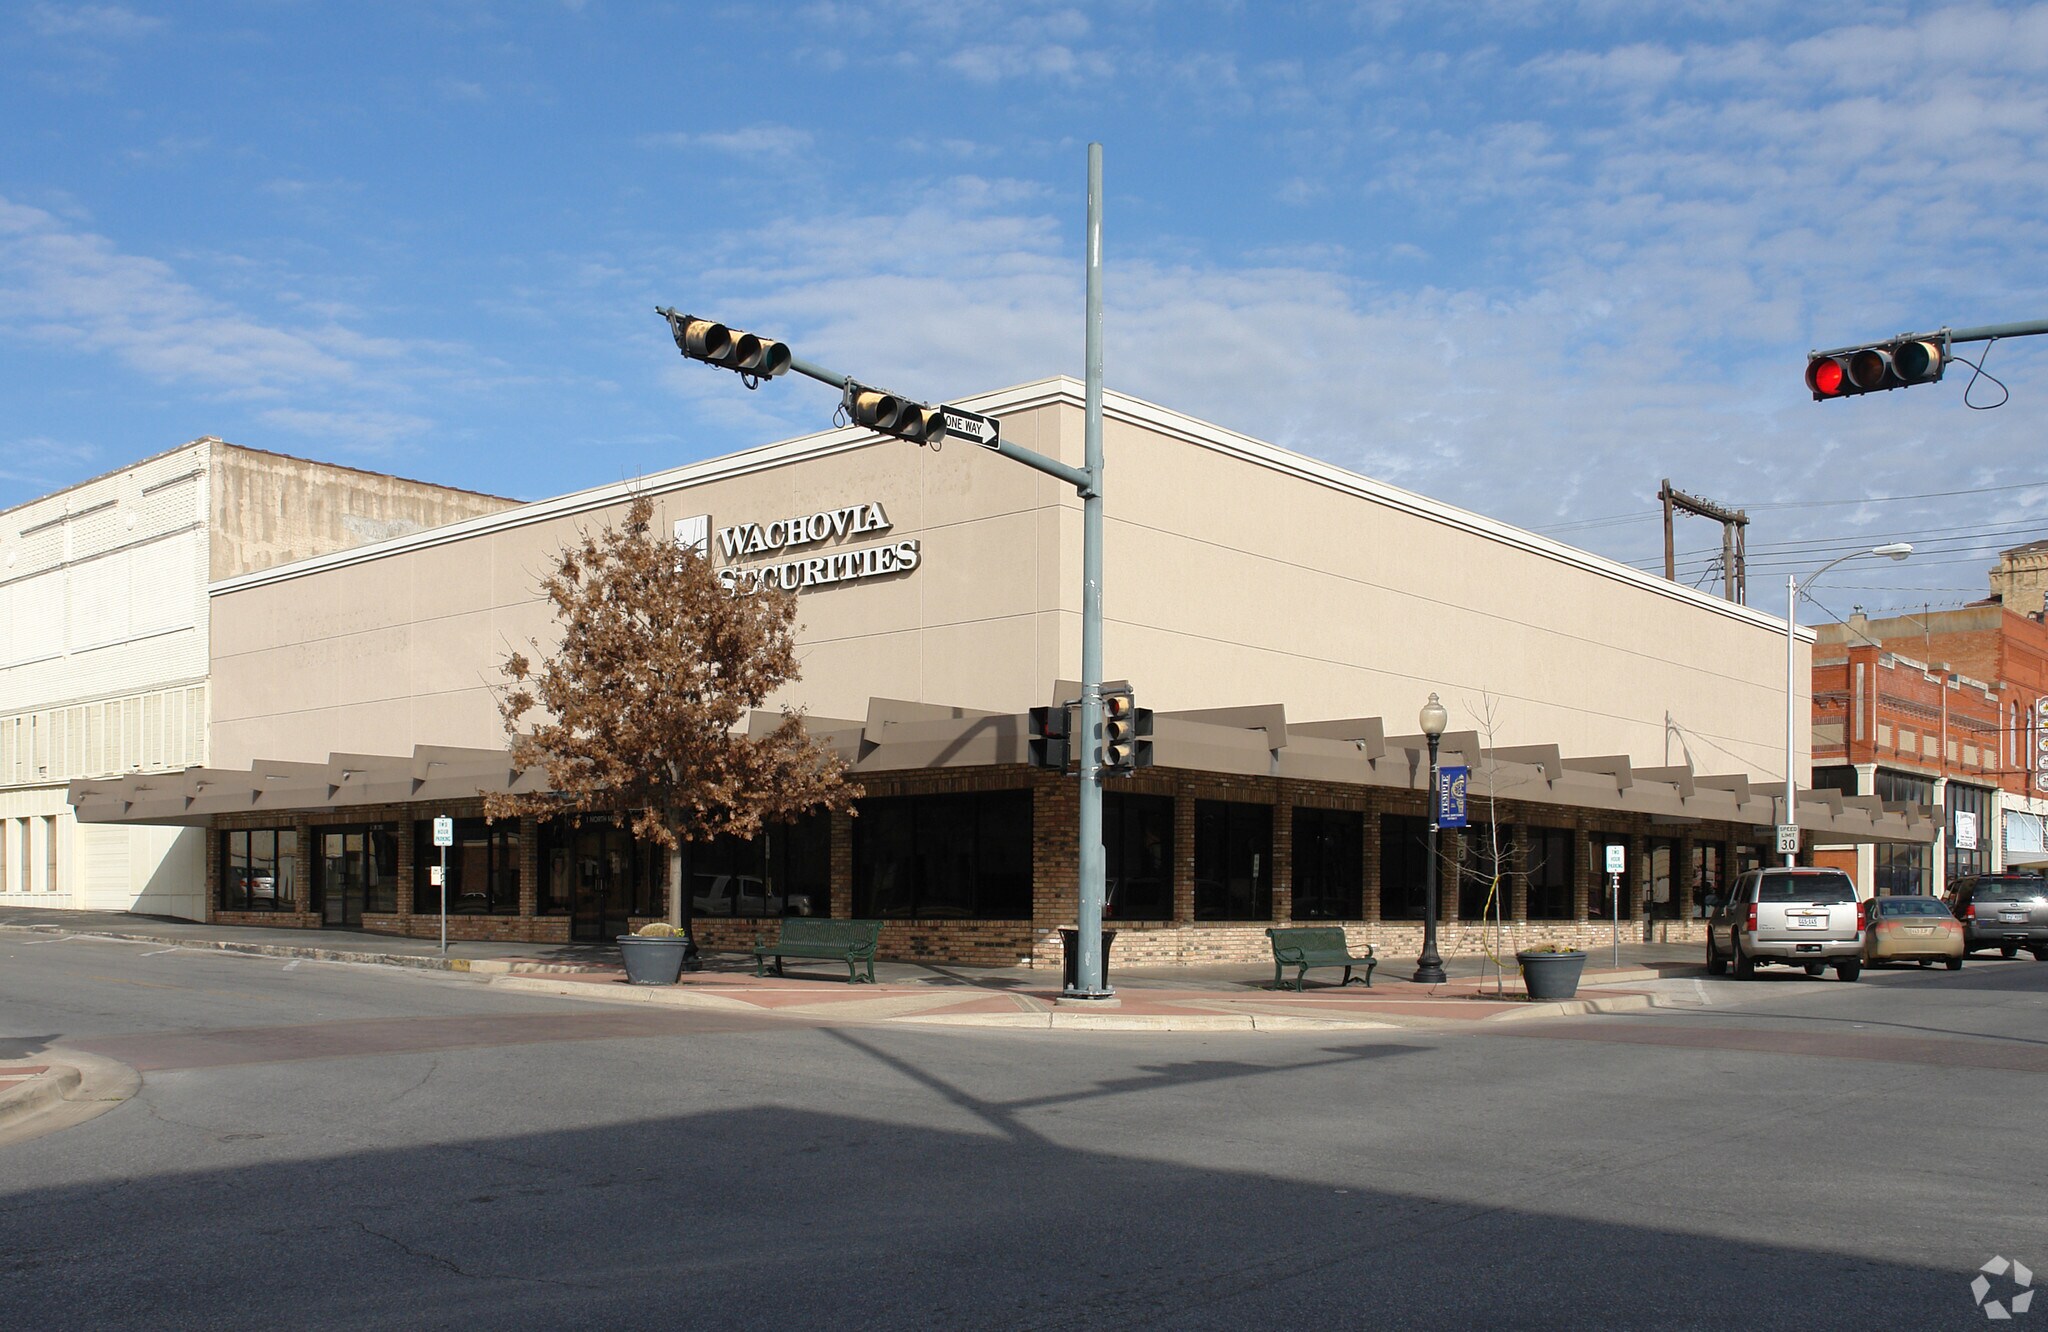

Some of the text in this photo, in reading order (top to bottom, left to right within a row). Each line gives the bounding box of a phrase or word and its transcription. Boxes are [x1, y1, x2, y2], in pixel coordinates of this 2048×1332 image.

[946, 415, 982, 435] ONE WAY
[717, 501, 893, 558] WACHOVIA
[1441, 774, 1451, 815] TEMPLE
[1781, 839, 1796, 850] 30
